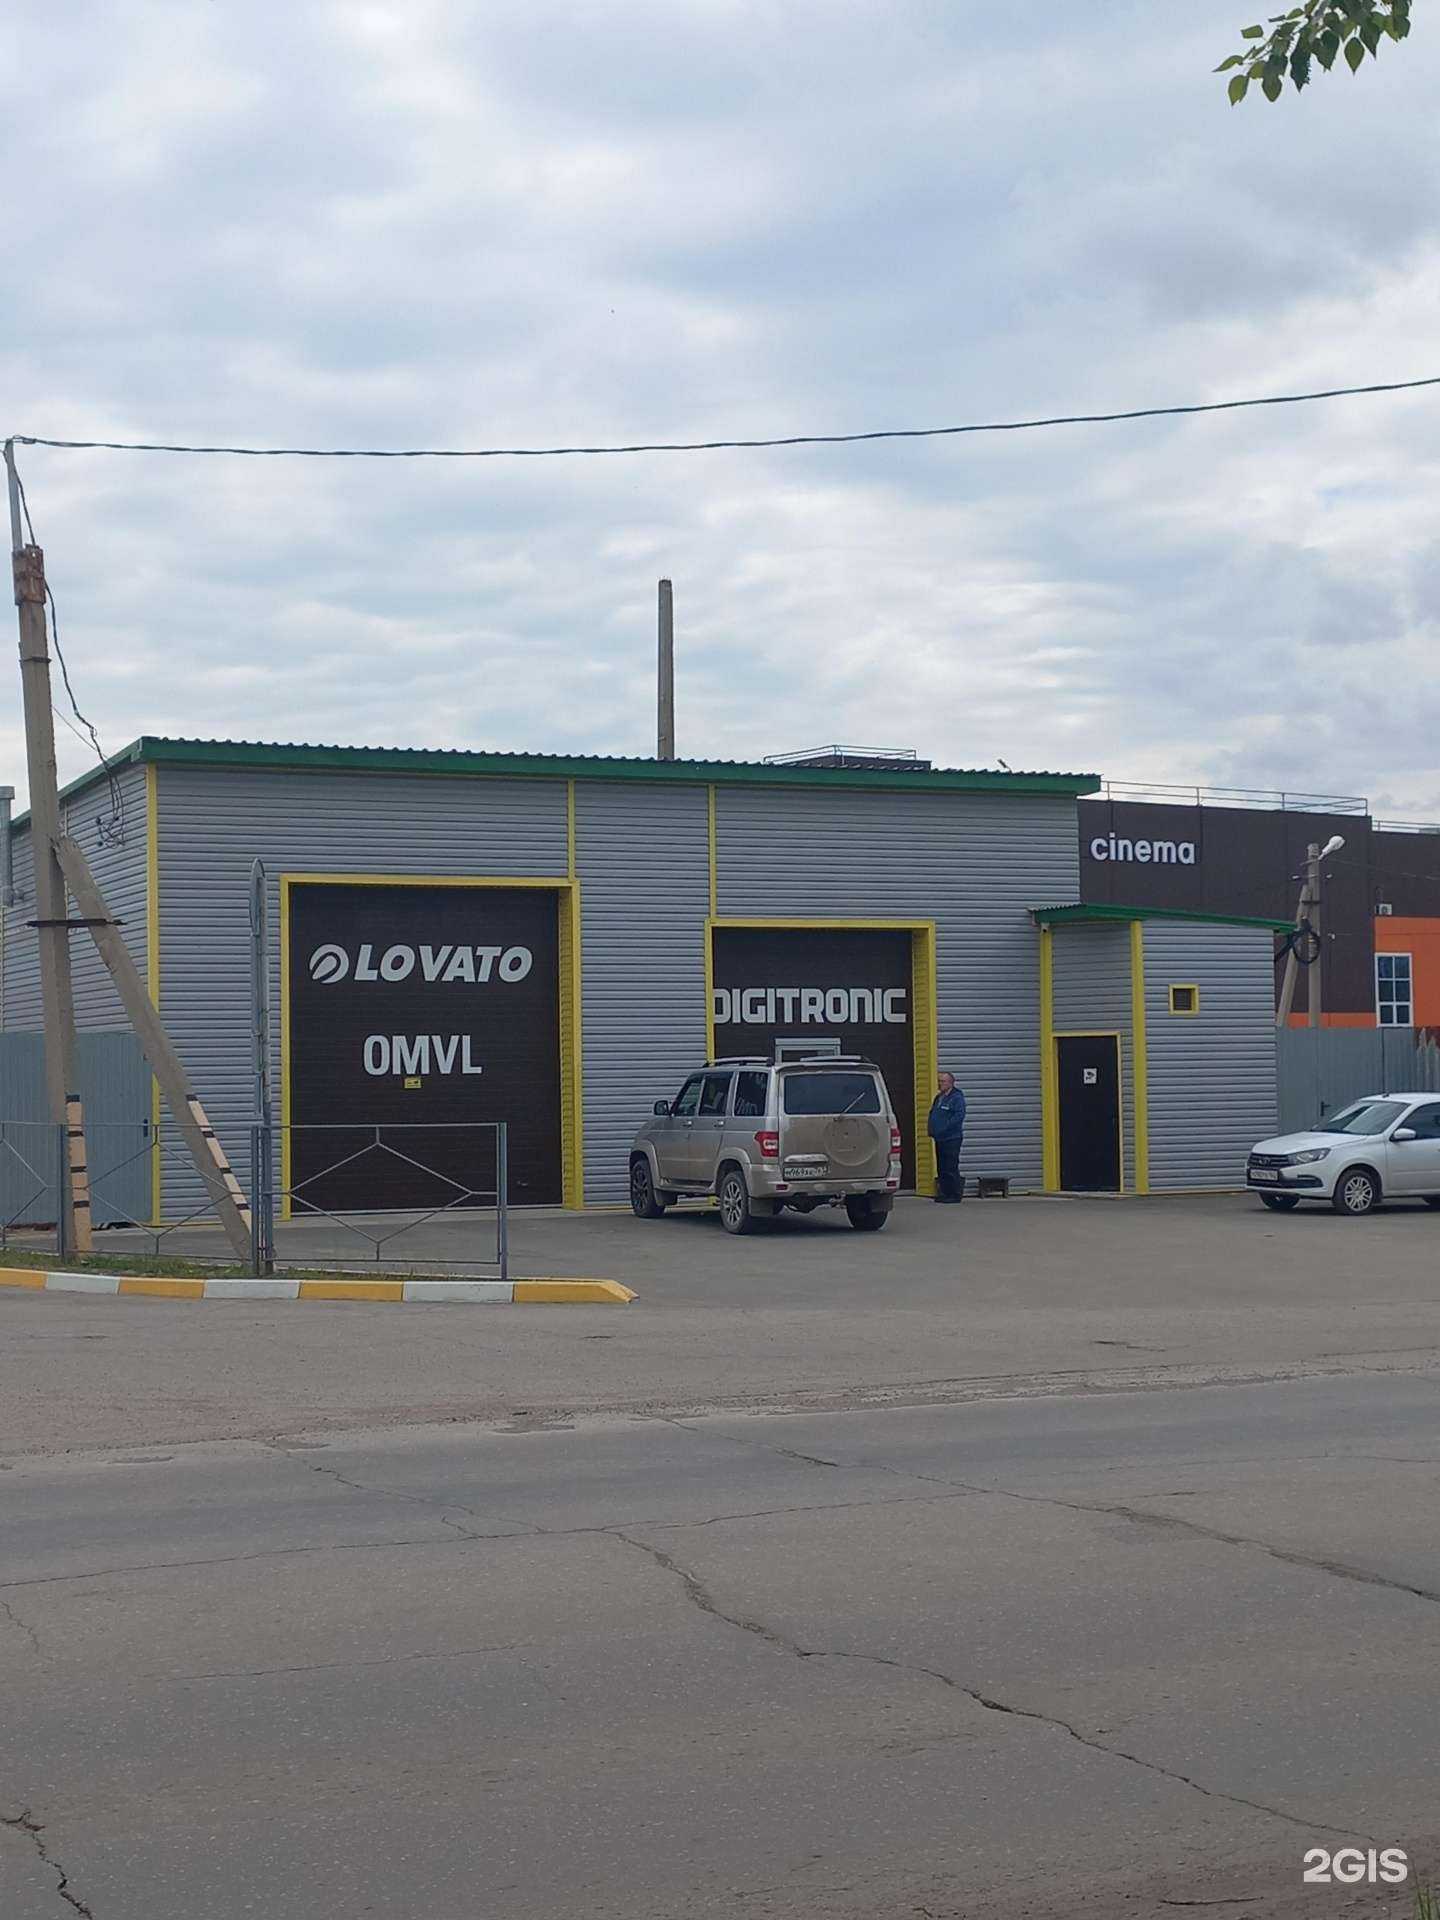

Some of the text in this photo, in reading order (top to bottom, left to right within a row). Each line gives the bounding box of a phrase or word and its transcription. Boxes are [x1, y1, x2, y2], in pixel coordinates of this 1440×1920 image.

[1090, 832, 1195, 864] cinema
[354, 944, 533, 983] LOVATO
[713, 988, 906, 1024] DIGITRONIC
[363, 1034, 482, 1076] OMVL
